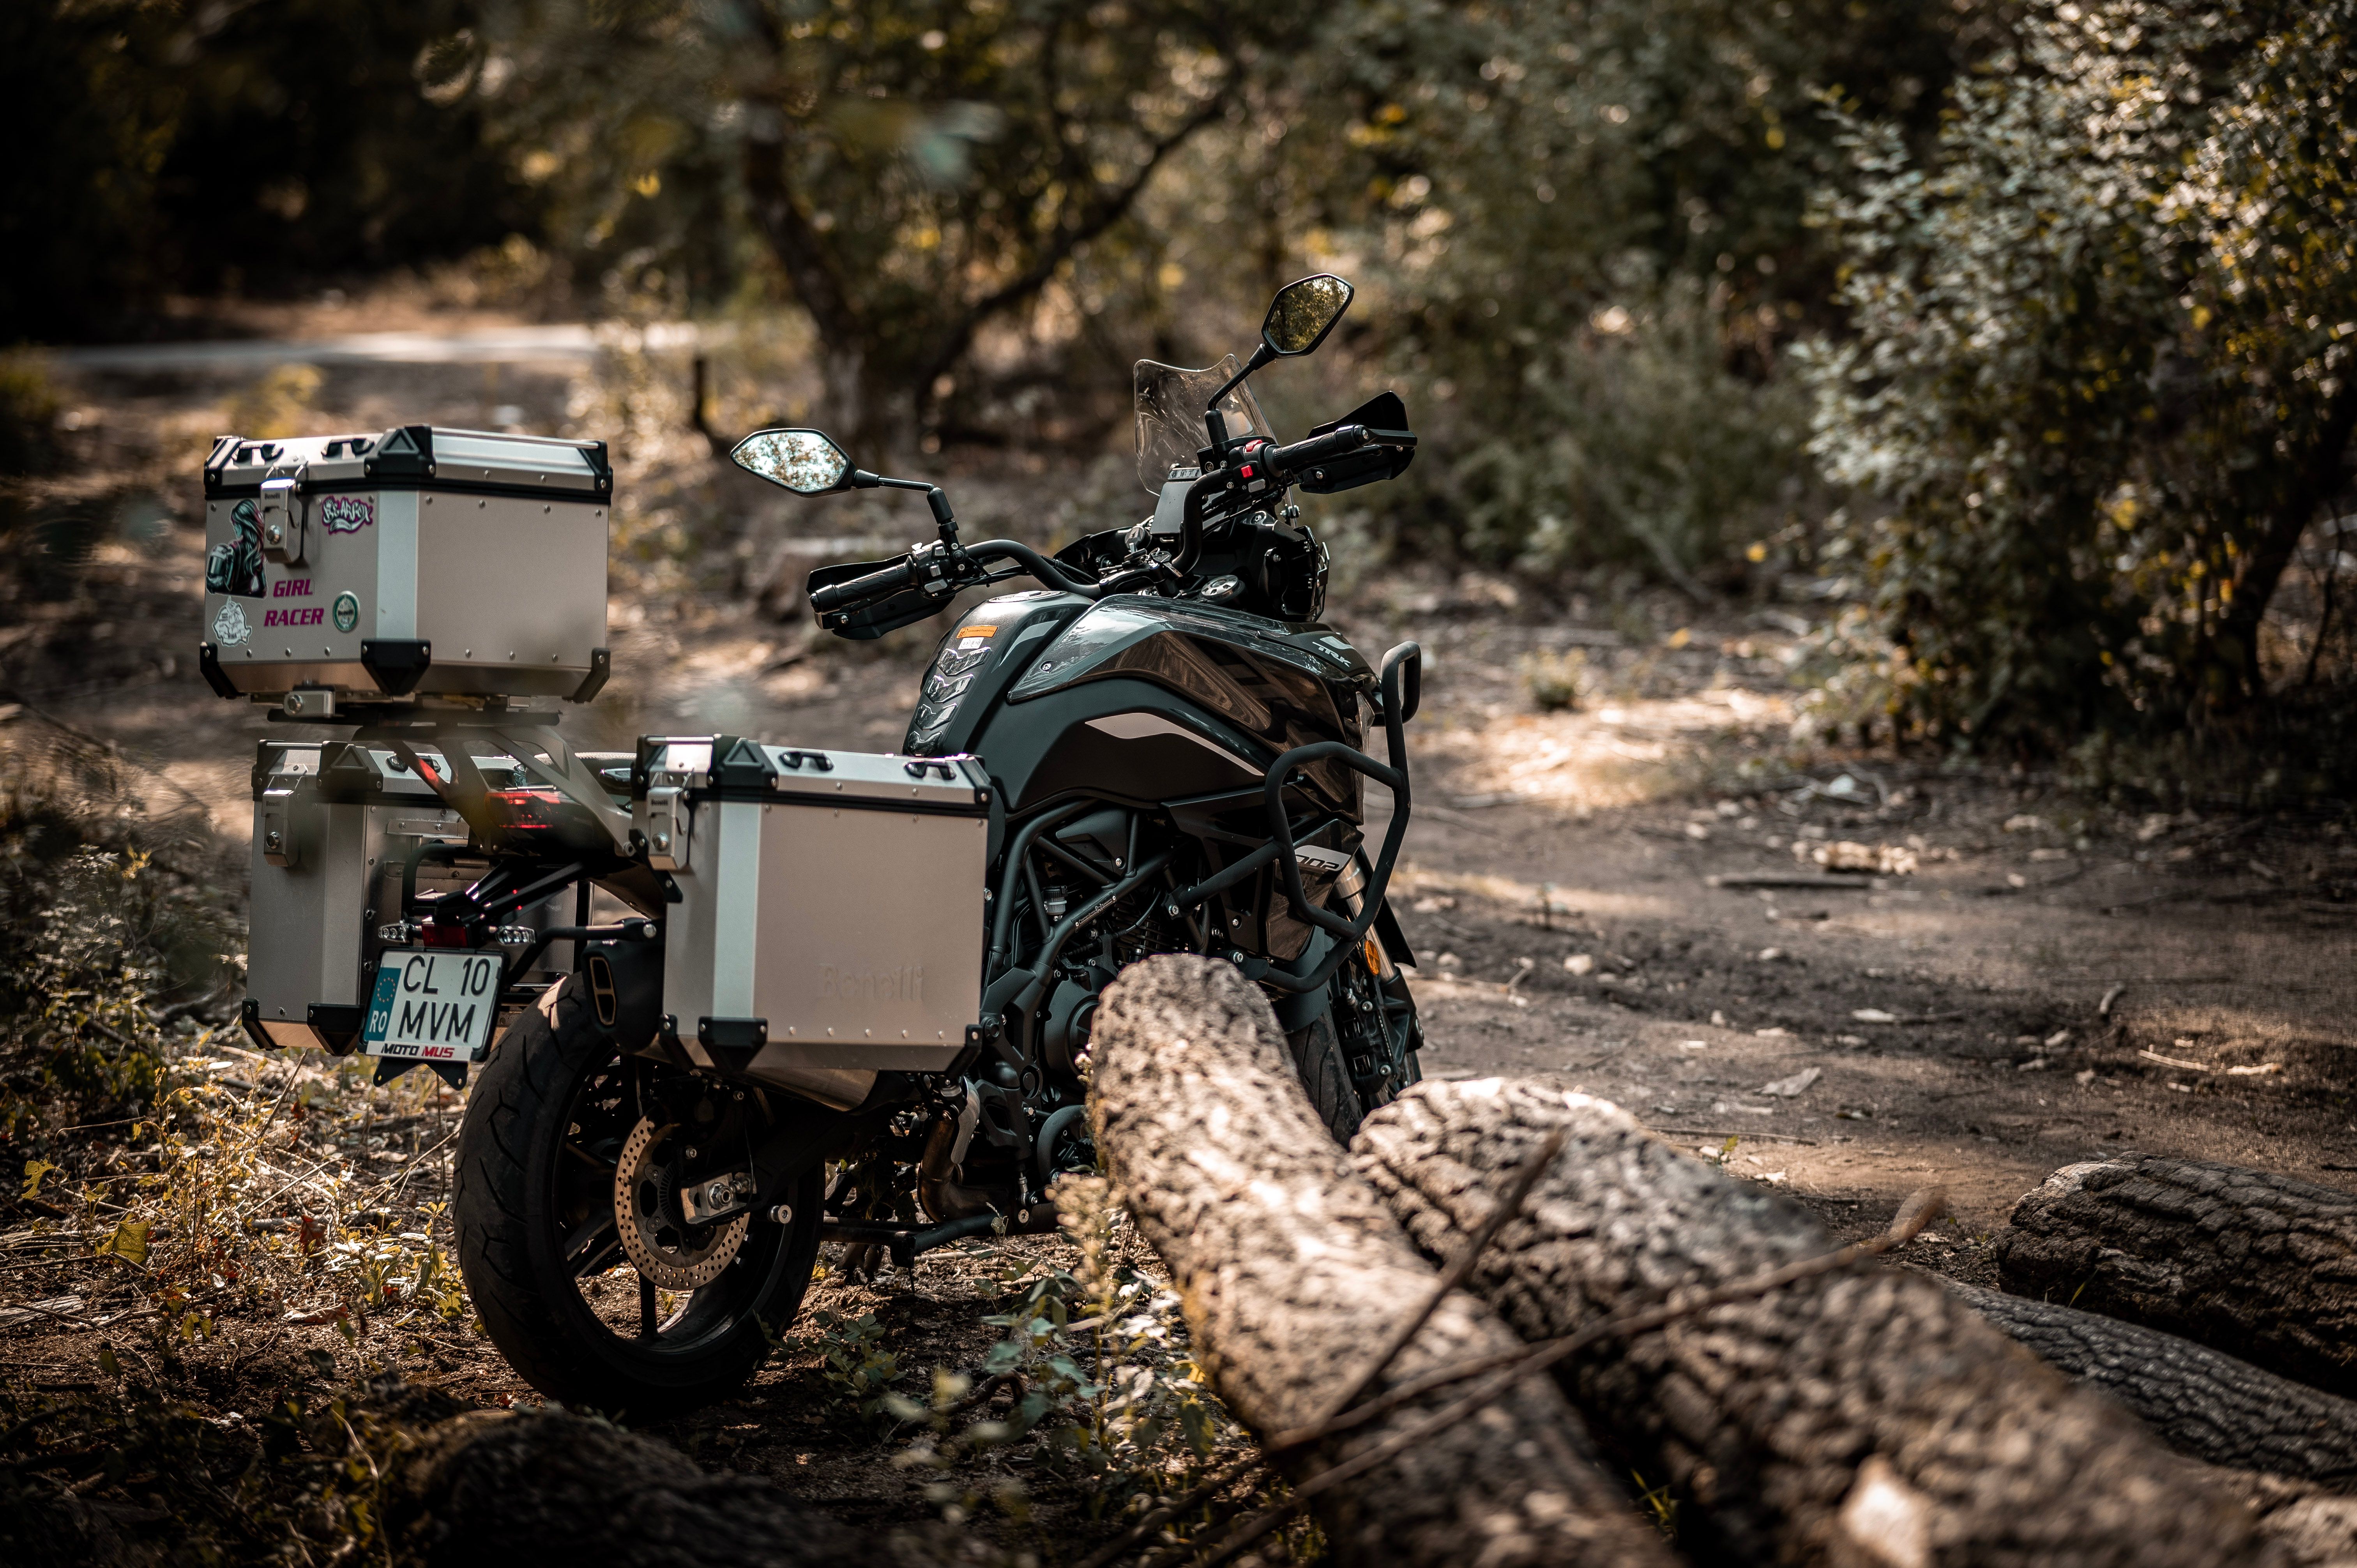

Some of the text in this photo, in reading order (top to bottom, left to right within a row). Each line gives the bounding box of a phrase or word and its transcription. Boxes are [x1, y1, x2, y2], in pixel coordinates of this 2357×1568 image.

[273, 578, 313, 597] GIRL
[264, 607, 325, 627] RACER
[1312, 641, 1351, 667] TRK
[403, 954, 491, 996] CL 10
[368, 1010, 388, 1033] RO
[397, 999, 476, 1043] MVM
[381, 1043, 455, 1058] MOTO MUS
